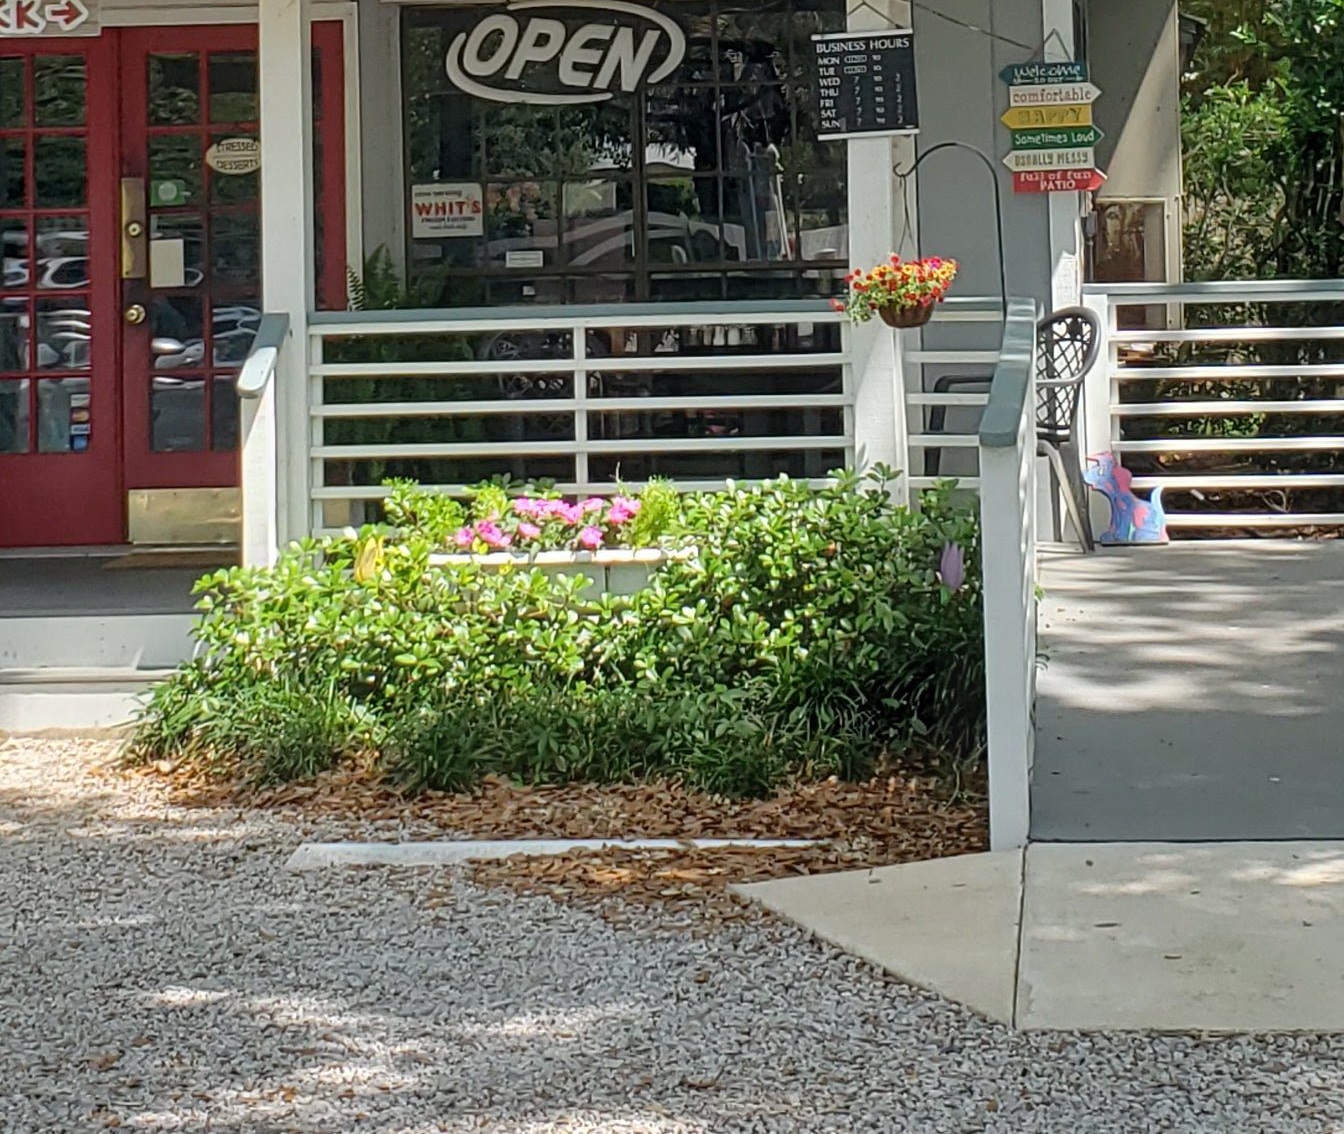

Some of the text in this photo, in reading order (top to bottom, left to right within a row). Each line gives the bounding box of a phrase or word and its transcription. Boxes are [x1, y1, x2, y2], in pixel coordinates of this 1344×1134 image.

[816, 38, 910, 53] BUSINESS HOURS
[463, 14, 661, 92] OPEN
[817, 57, 841, 65] MON
[819, 67, 835, 76] TUE
[819, 77, 841, 86] WED
[820, 88, 839, 97] THU
[1013, 87, 1092, 104] comfortable
[820, 99, 834, 108] FRI
[821, 109, 836, 118] SAT
[821, 119, 841, 128] SUN
[1014, 151, 1089, 167] USUALLY MESSY
[1039, 180, 1076, 190] PATIO
[414, 199, 481, 216] WHIT'S
